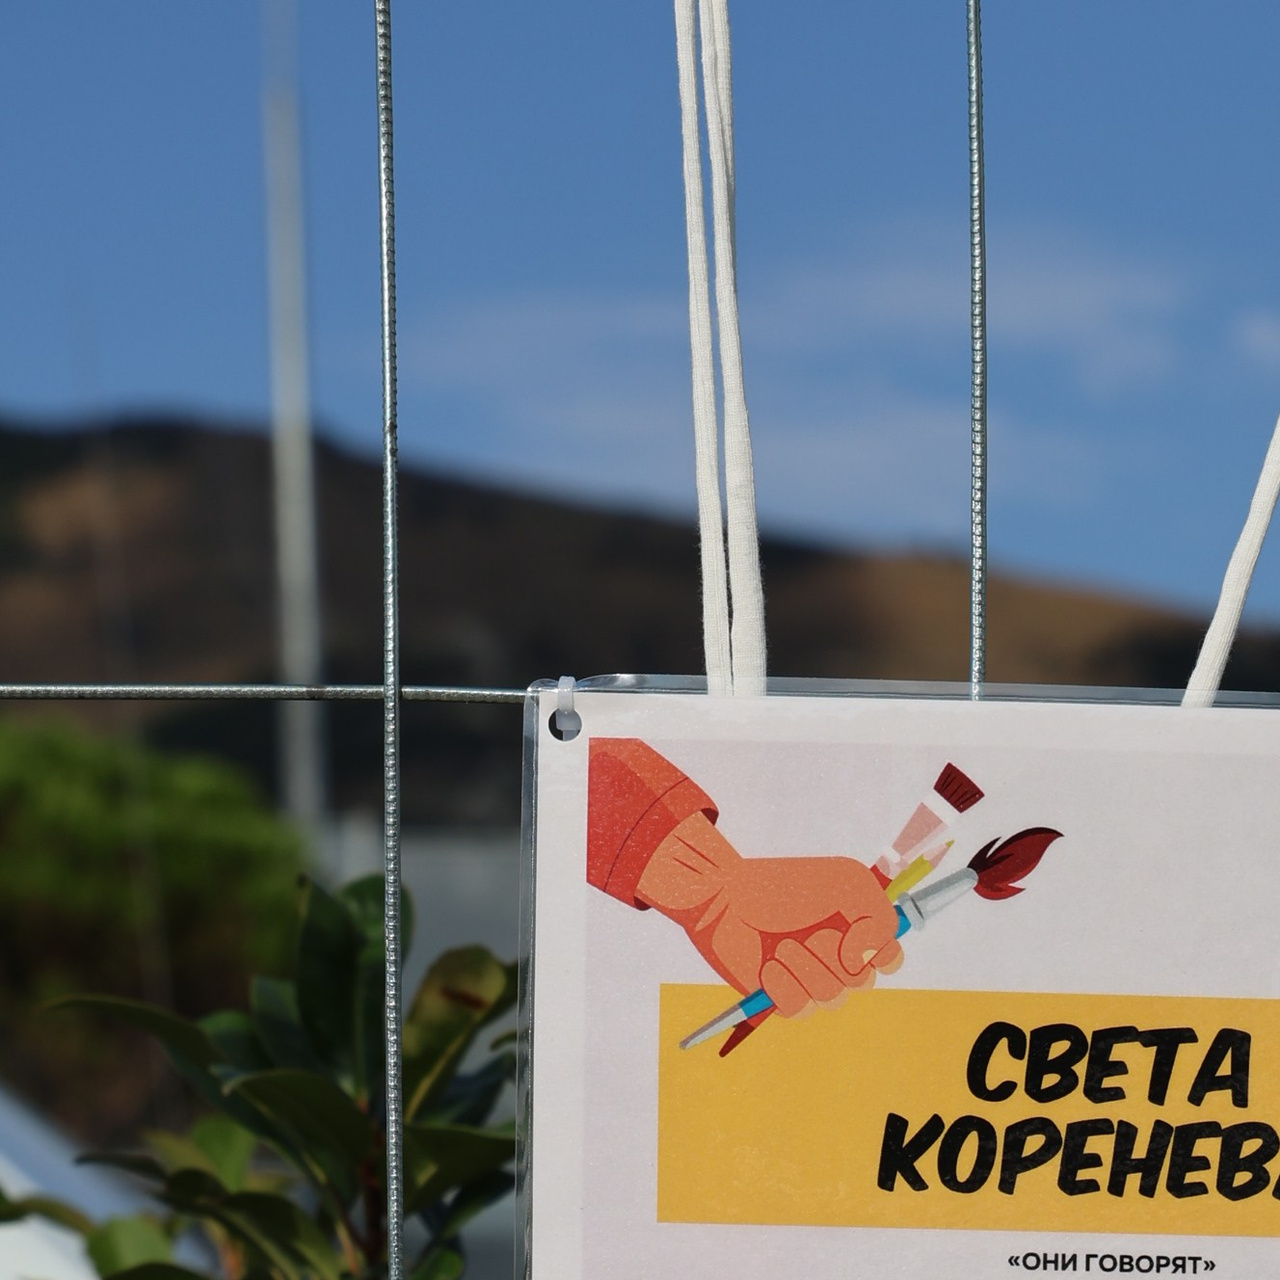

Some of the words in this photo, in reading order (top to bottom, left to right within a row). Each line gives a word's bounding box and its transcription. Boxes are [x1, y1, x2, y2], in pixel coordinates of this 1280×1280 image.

[966, 1021, 1252, 1109] СВЕТА
[1008, 1252, 1078, 1272] «ОНИ
[1085, 1253, 1216, 1275] ГОВОРЯТ»
